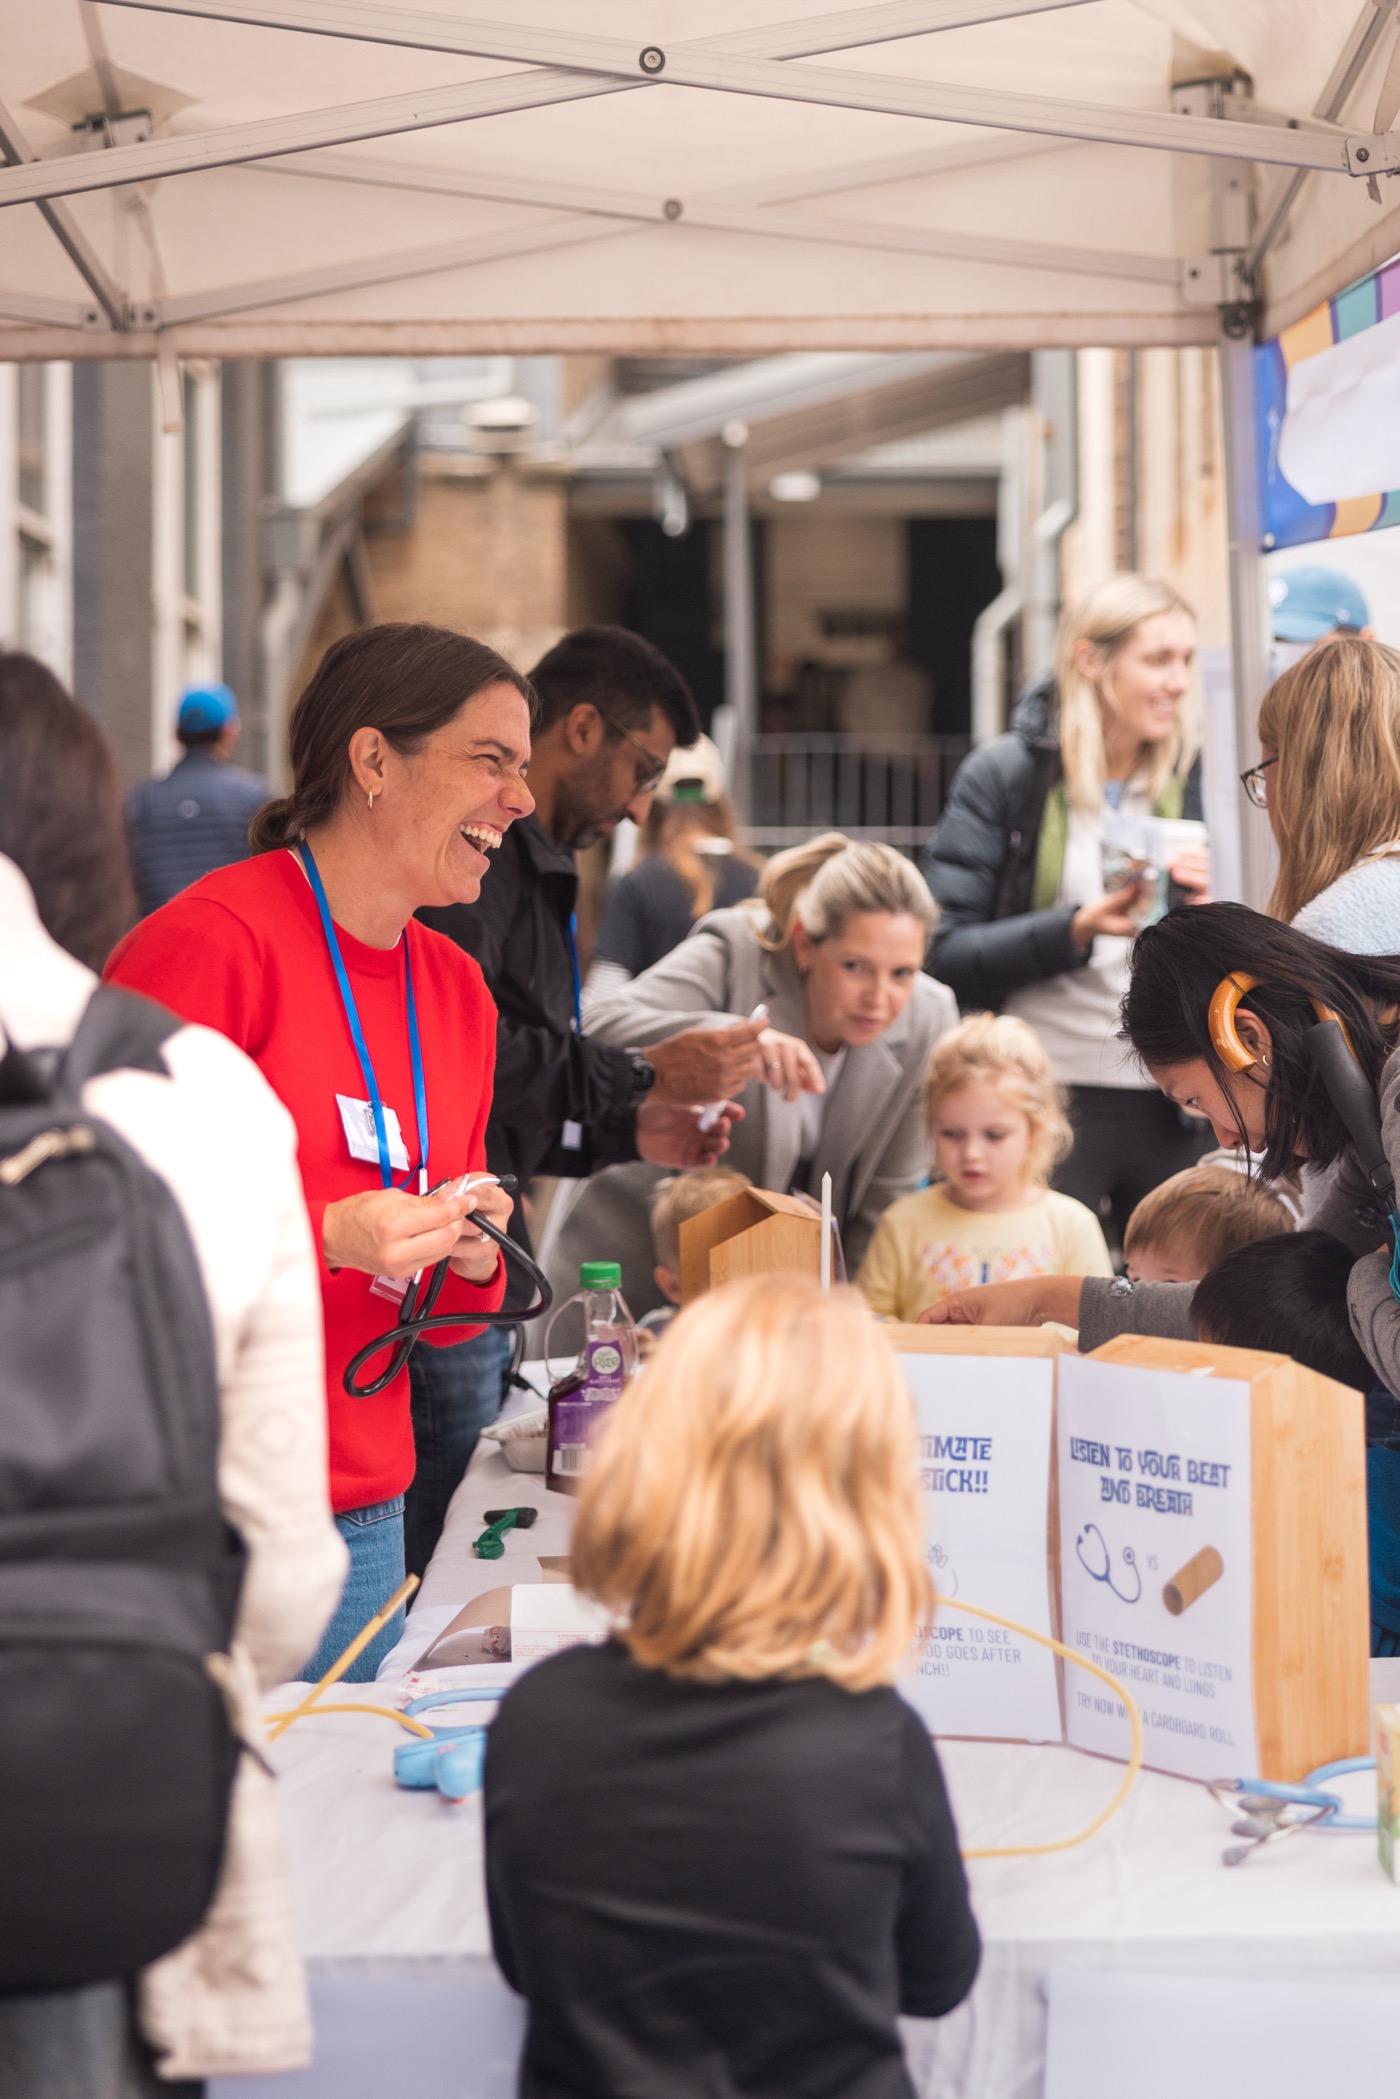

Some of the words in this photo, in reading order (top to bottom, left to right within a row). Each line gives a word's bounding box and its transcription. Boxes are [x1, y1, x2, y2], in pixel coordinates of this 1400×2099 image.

[916, 1435, 992, 1461] TIMATE
[1070, 1437, 1110, 1468] LISTEN
[1115, 1446, 1133, 1472] TO
[1138, 1450, 1181, 1481] YOUR
[1186, 1459, 1231, 1488] BEAT
[1100, 1476, 1131, 1505] AND
[1136, 1482, 1193, 1516] BREATH
[946, 1645, 978, 1661] GOES
[982, 1647, 1021, 1664] AFTER
[968, 1628, 984, 1644] TO
[987, 1629, 1011, 1645] SEE
[1076, 1630, 1091, 1649] USE
[1094, 1634, 1110, 1654] THE
[1112, 1640, 1181, 1670] STETHOSCOPE
[1184, 1656, 1196, 1675] TO
[1199, 1660, 1232, 1683] LISTEN
[916, 1661, 950, 1677] NCH!!
[1091, 1653, 1104, 1668] TO
[1104, 1656, 1128, 1679] YOUR
[1130, 1665, 1159, 1684] HEART
[1162, 1672, 1181, 1691] AND
[1184, 1679, 1216, 1699] LUNGS
[1077, 1691, 1092, 1710] TRY
[1094, 1697, 1114, 1716] NOW
[1143, 1708, 1149, 1725] A
[1151, 1711, 1207, 1740] CARDBOARD
[1209, 1725, 1235, 1747] ROLL
